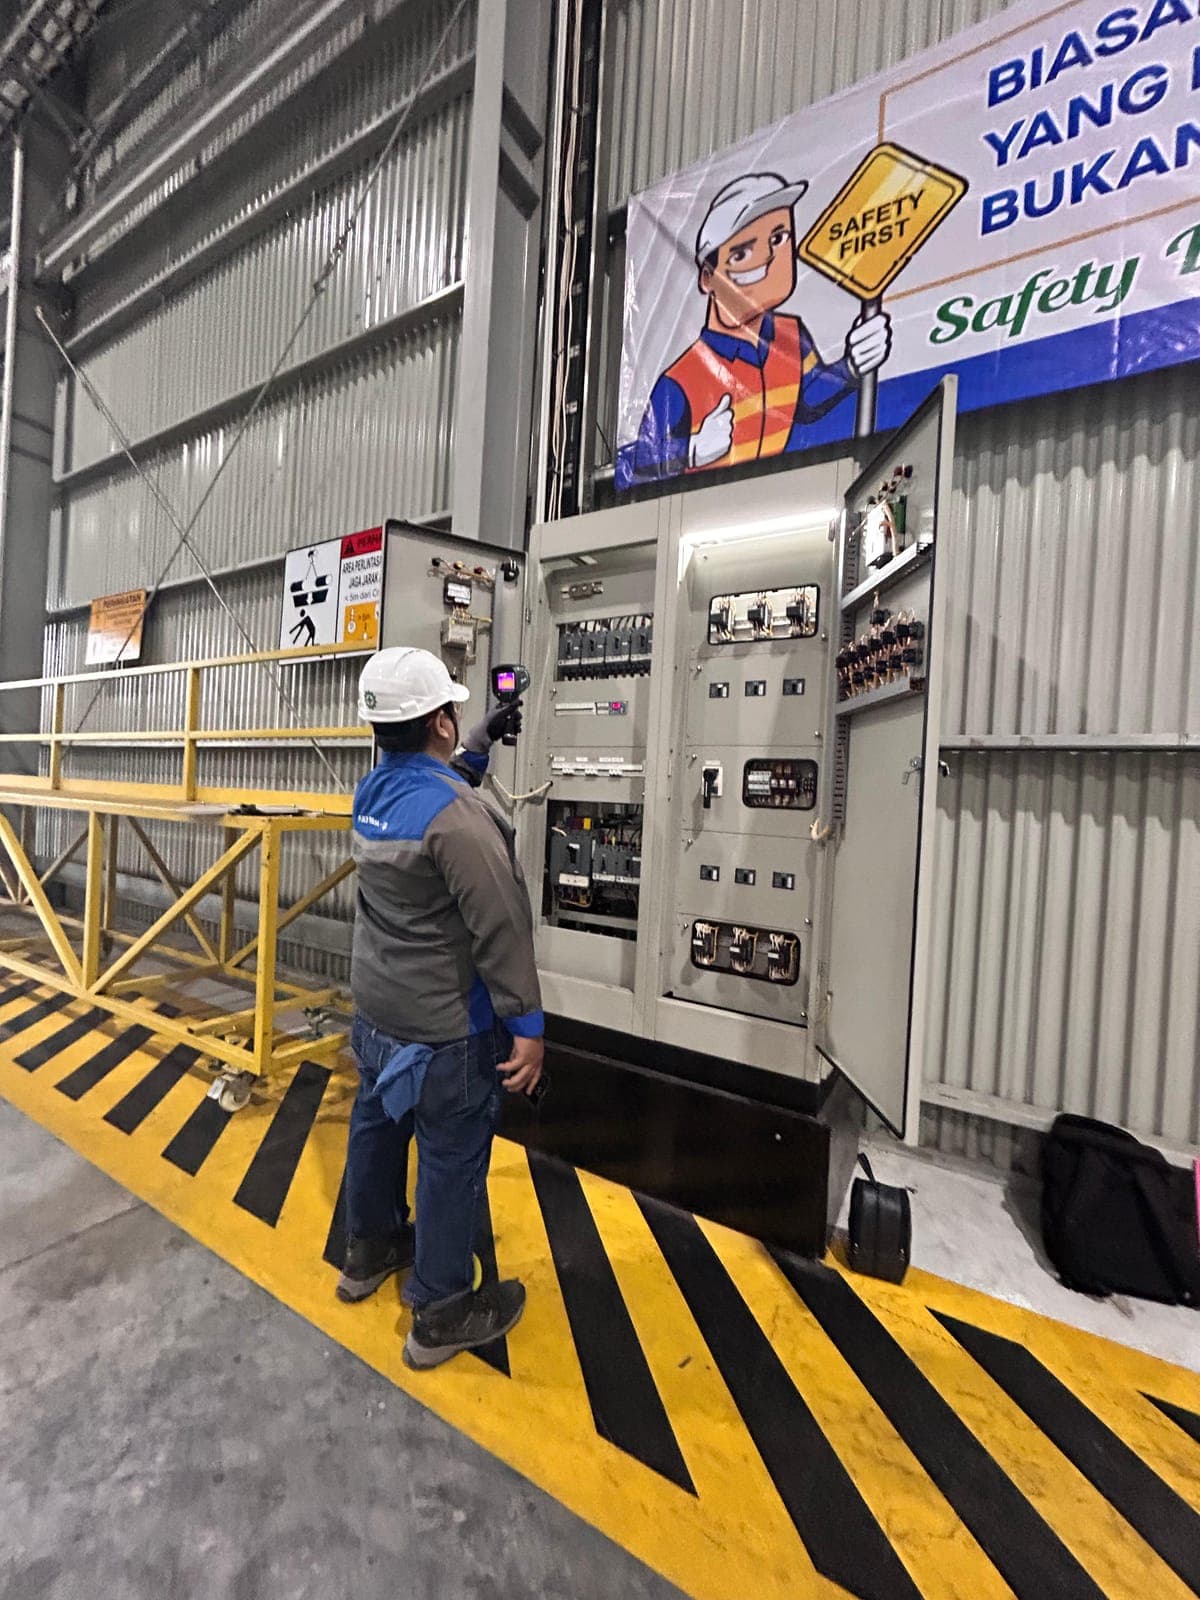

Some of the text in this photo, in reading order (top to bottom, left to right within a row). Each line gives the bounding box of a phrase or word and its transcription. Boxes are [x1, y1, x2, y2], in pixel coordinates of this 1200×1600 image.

[988, 0, 1200, 107] BIASA
[983, 64, 1168, 167] YANG
[829, 189, 925, 242] SAFETY
[840, 218, 910, 260] FIRST
[930, 257, 1139, 345] Safety
[343, 561, 354, 574] AREA
[348, 572, 378, 589] JAGA JARAK
